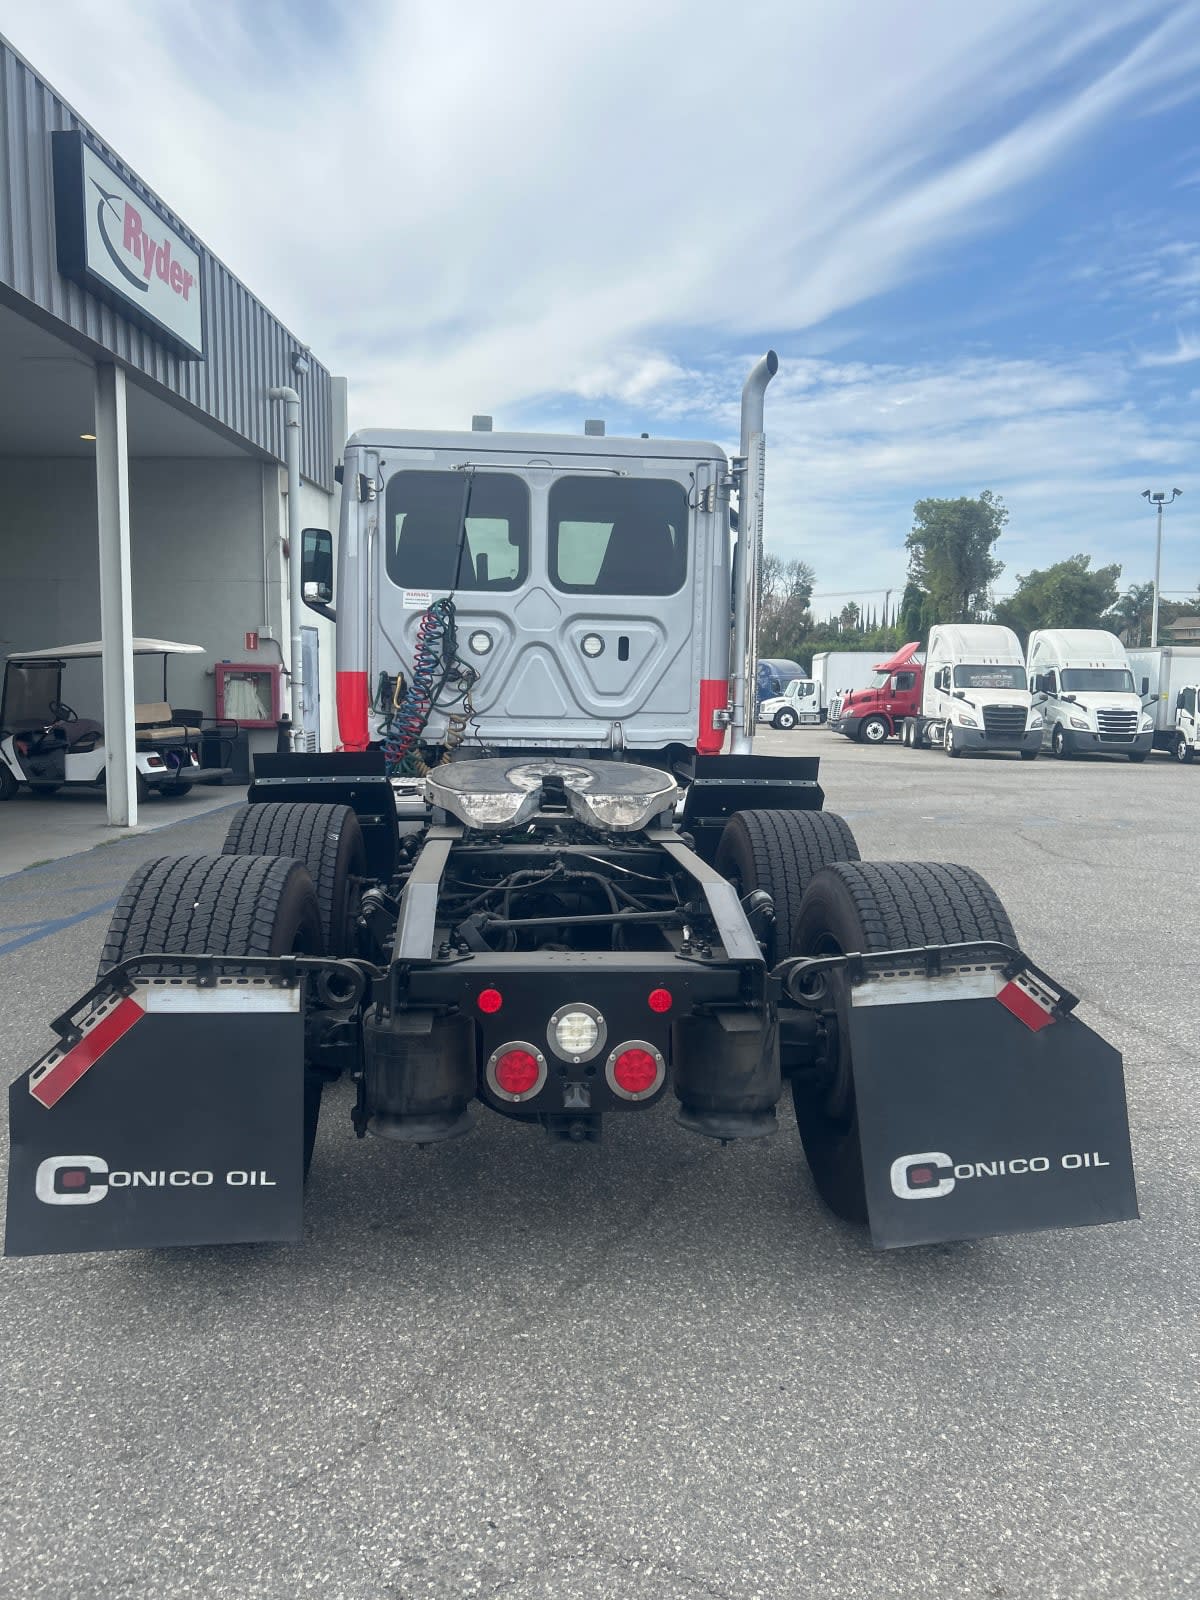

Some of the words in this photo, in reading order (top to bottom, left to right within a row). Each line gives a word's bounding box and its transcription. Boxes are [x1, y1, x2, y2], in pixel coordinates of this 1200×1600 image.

[123, 201, 193, 303] Ryder
[36, 1155, 214, 1205] CONICO
[226, 1171, 277, 1186] OIL
[890, 1152, 1050, 1199] CONICO
[1061, 1152, 1110, 1170] OIL
